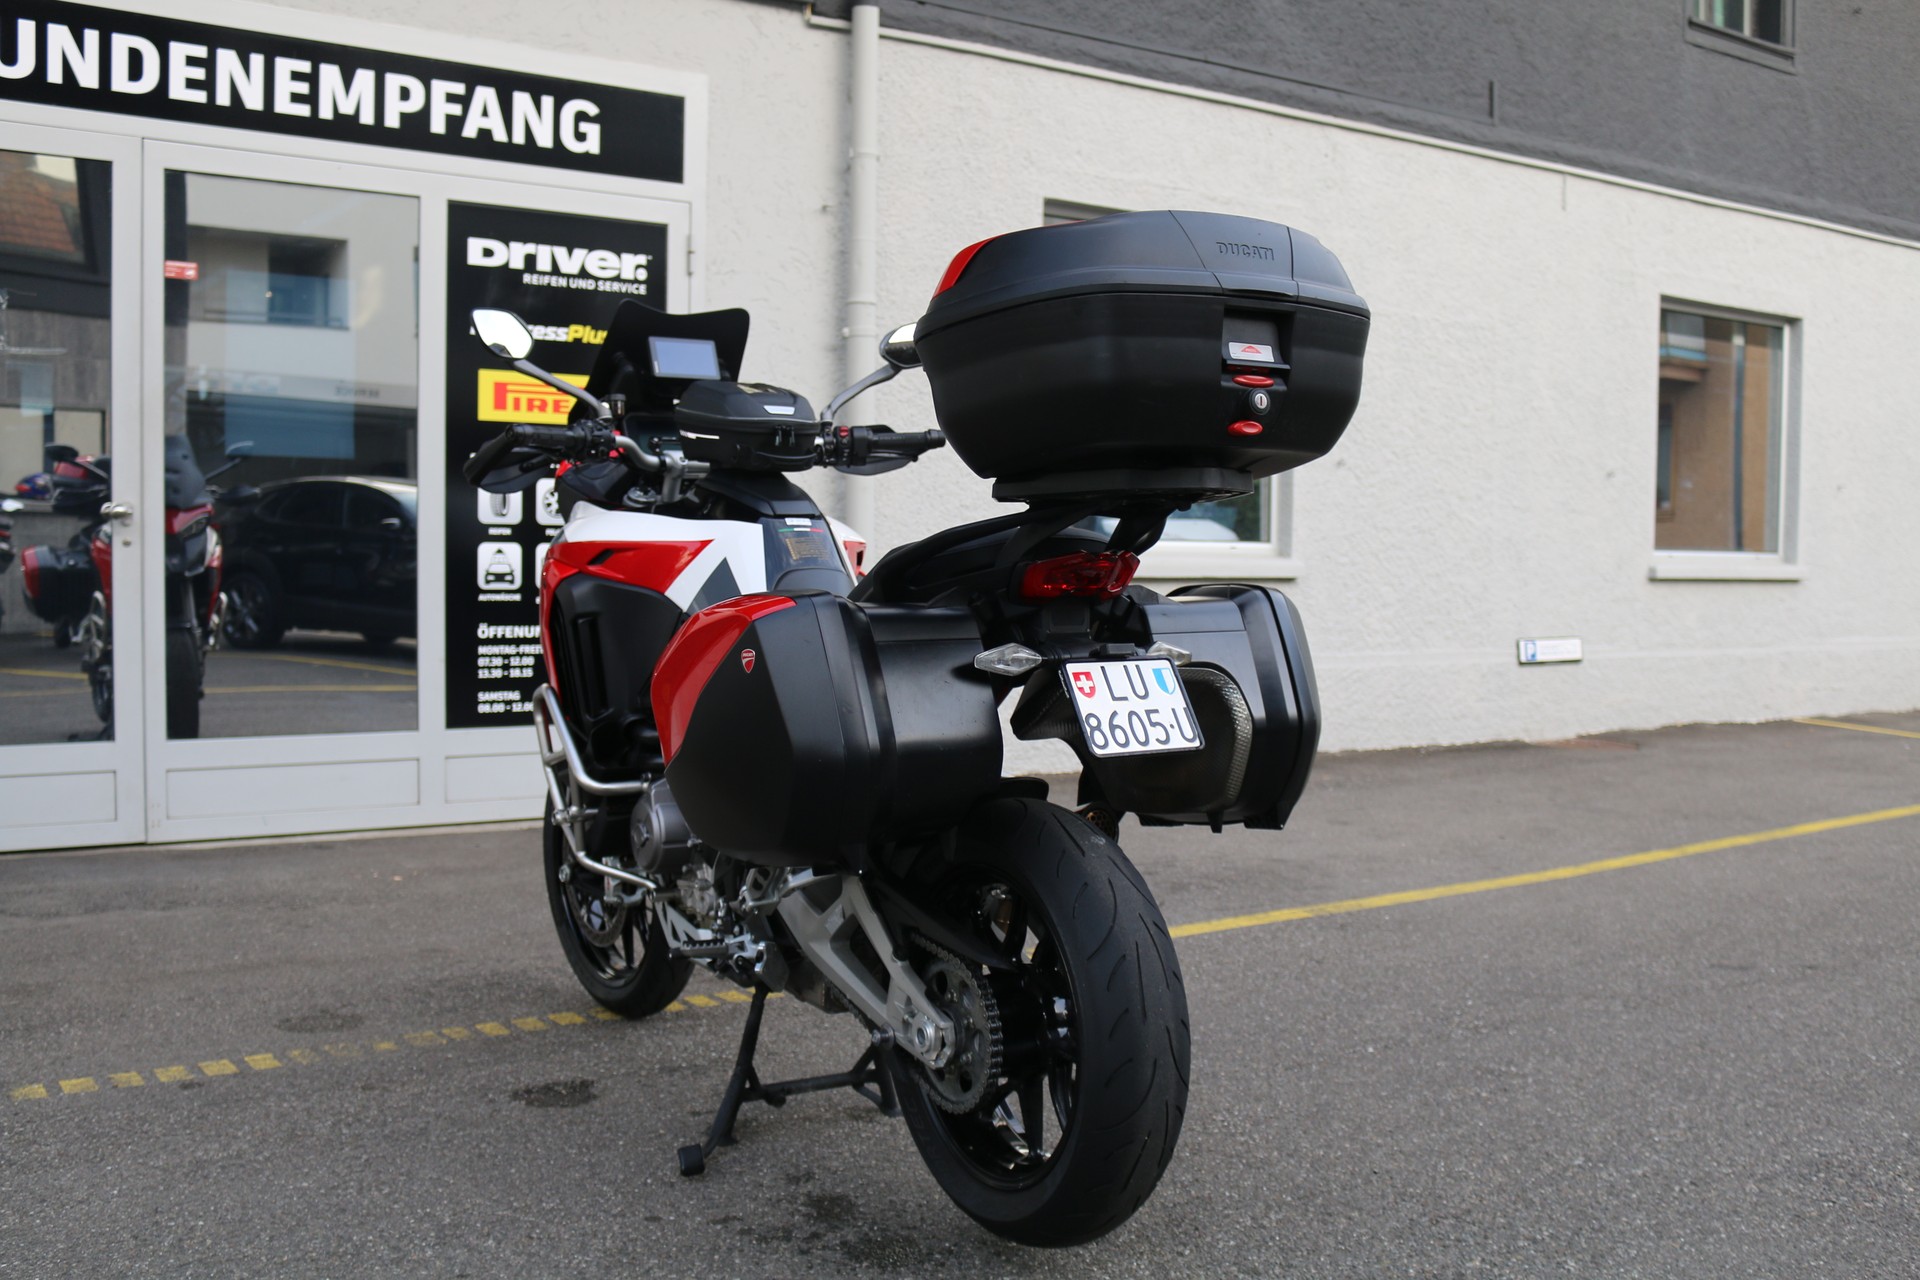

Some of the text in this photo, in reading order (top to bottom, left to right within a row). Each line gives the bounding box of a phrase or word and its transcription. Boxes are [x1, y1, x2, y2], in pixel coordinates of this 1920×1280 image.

[1216, 241, 1274, 261] DUCATI
[523, 273, 647, 296] REIFEN UND SERVICE
[1099, 663, 1149, 702] LU
[477, 690, 521, 702] SAMSTAG
